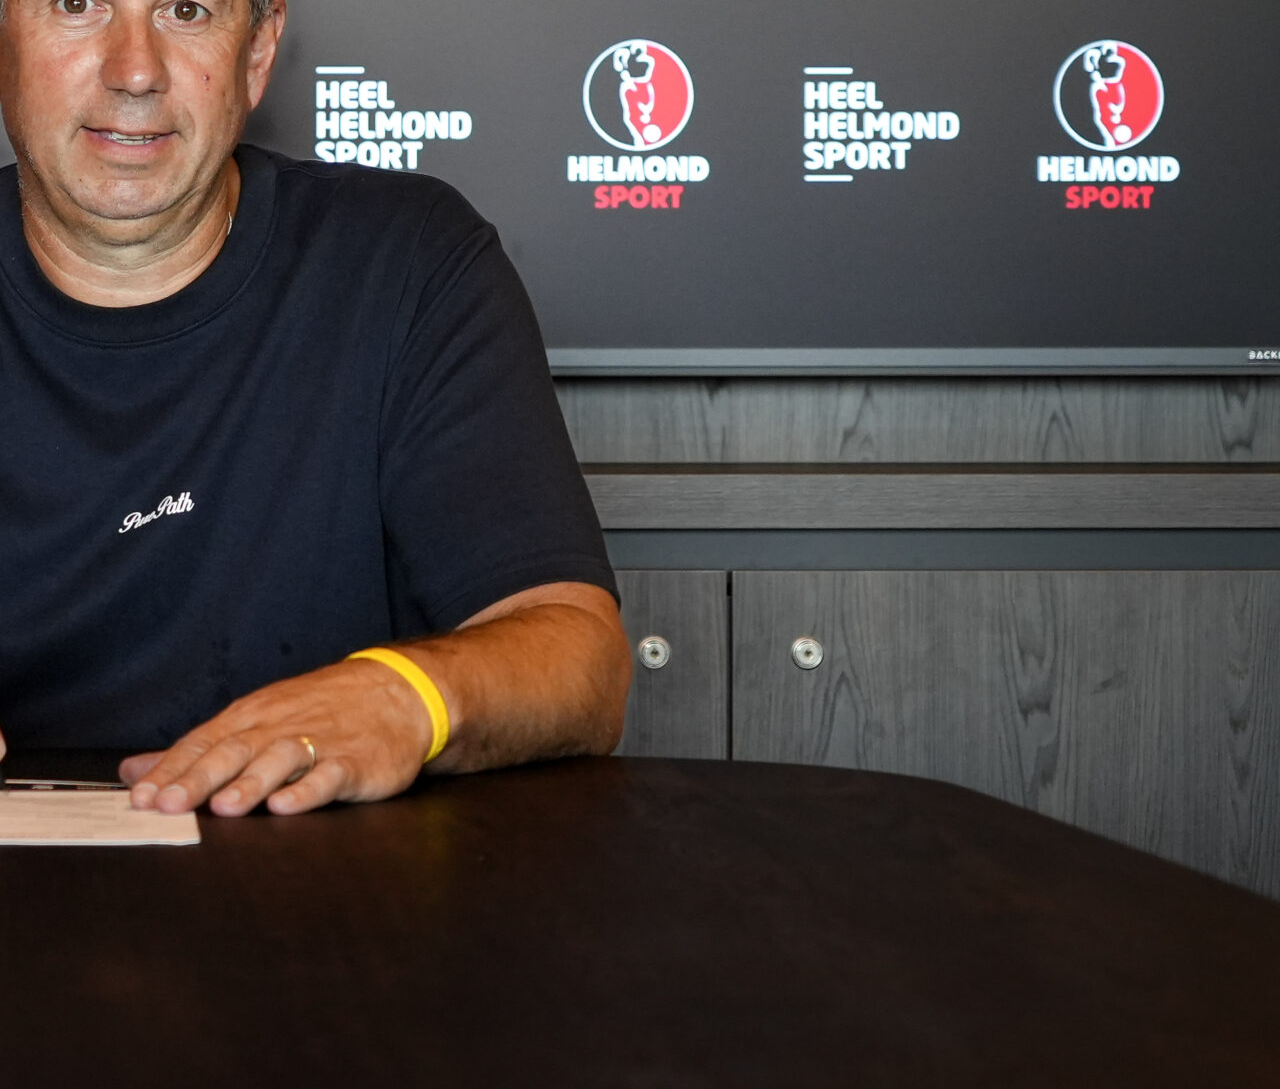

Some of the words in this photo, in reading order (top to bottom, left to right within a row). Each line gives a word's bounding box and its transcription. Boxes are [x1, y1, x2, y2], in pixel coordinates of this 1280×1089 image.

[315, 80, 396, 110] HEEL
[803, 81, 884, 110] HEEL
[315, 110, 473, 140] HELMOND
[804, 111, 960, 140] HELMOND
[314, 140, 424, 170] SPORT
[567, 155, 710, 182] HELMOND
[803, 141, 912, 170] SPORT
[1037, 156, 1180, 182] HELMOND
[594, 184, 685, 210] SPORT
[1065, 184, 1155, 210] SPORT
